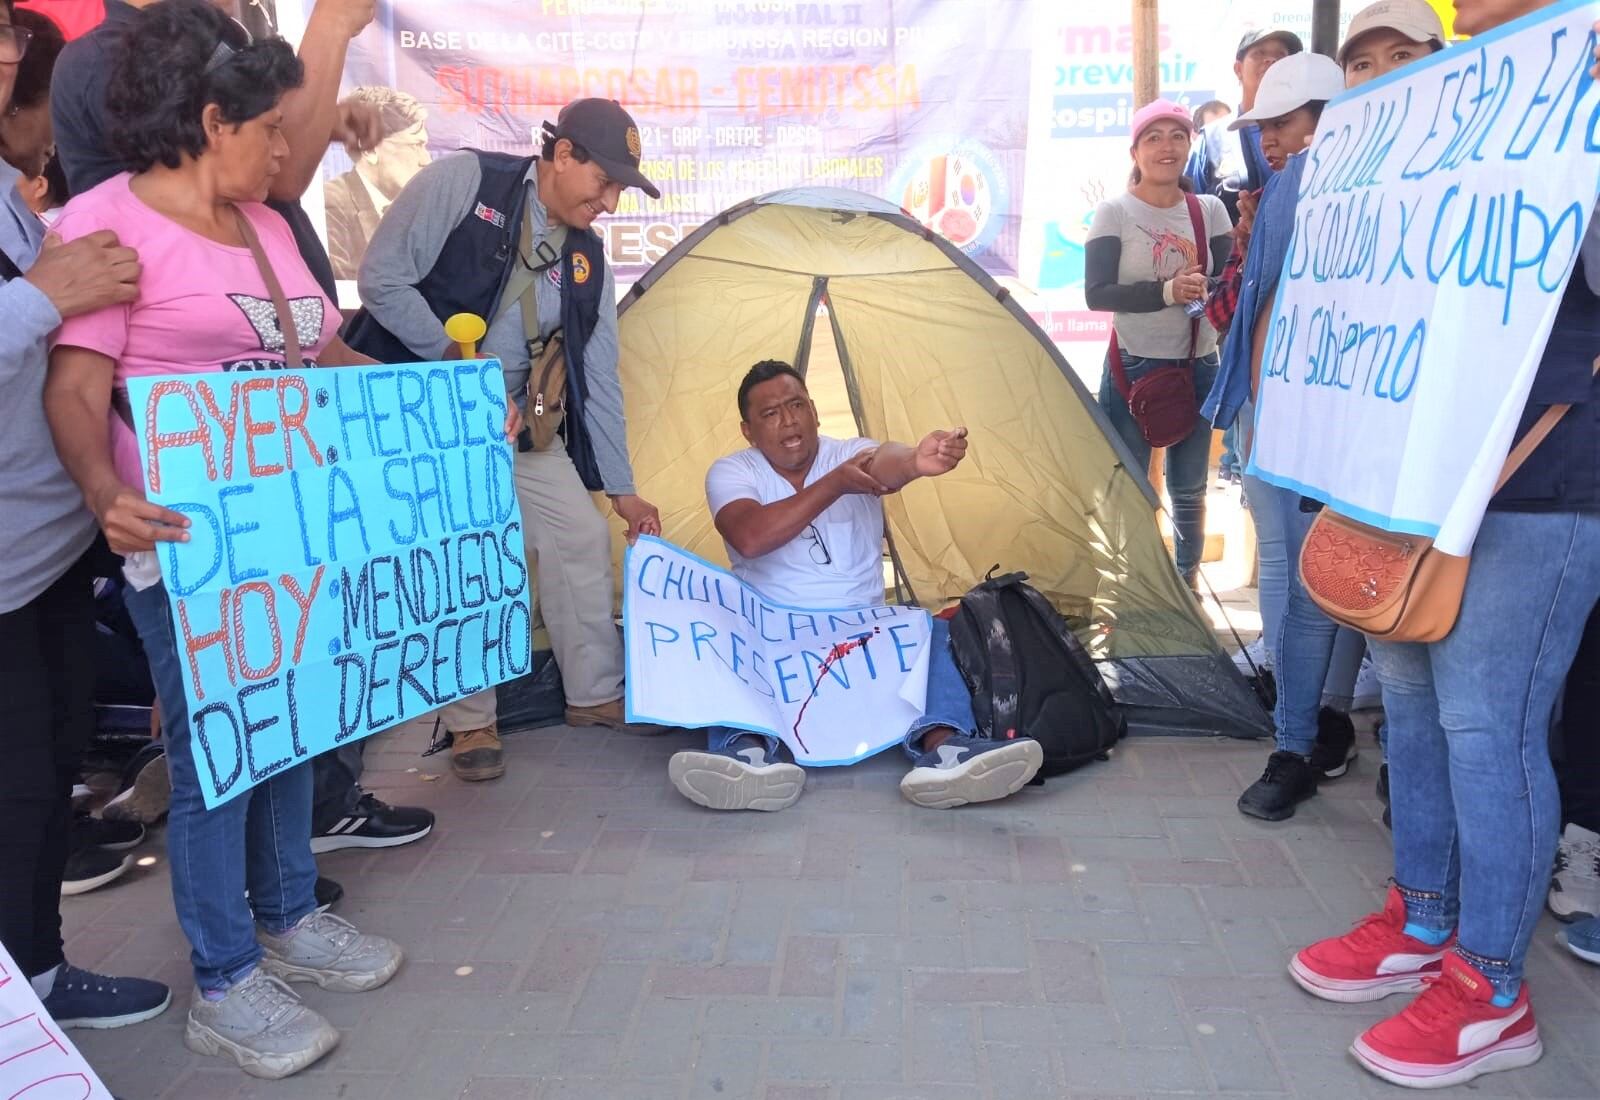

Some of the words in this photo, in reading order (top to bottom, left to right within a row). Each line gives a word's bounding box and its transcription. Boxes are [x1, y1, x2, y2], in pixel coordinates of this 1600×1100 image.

[400, 31, 462, 50] BASE
[467, 32, 496, 50] DE
[802, 28, 888, 48] REGION
[736, 64, 921, 115] FENUTSSA
[672, 126, 701, 147] GRP
[715, 126, 763, 147] DRTPE
[678, 160, 696, 181] DE
[699, 159, 724, 180] LOS
[804, 155, 884, 179] LABORALES
[1381, 194, 1423, 286] X
[1067, 318, 1107, 332] llama
[334, 360, 508, 460] HEROES
[165, 484, 269, 597] DE
[290, 465, 371, 567] LA
[383, 445, 516, 545] SALUD
[341, 522, 527, 649] MENDIGOS
[192, 668, 308, 799] DEL
[333, 600, 532, 743] DERECHO
[645, 620, 918, 704] PRESENTE
